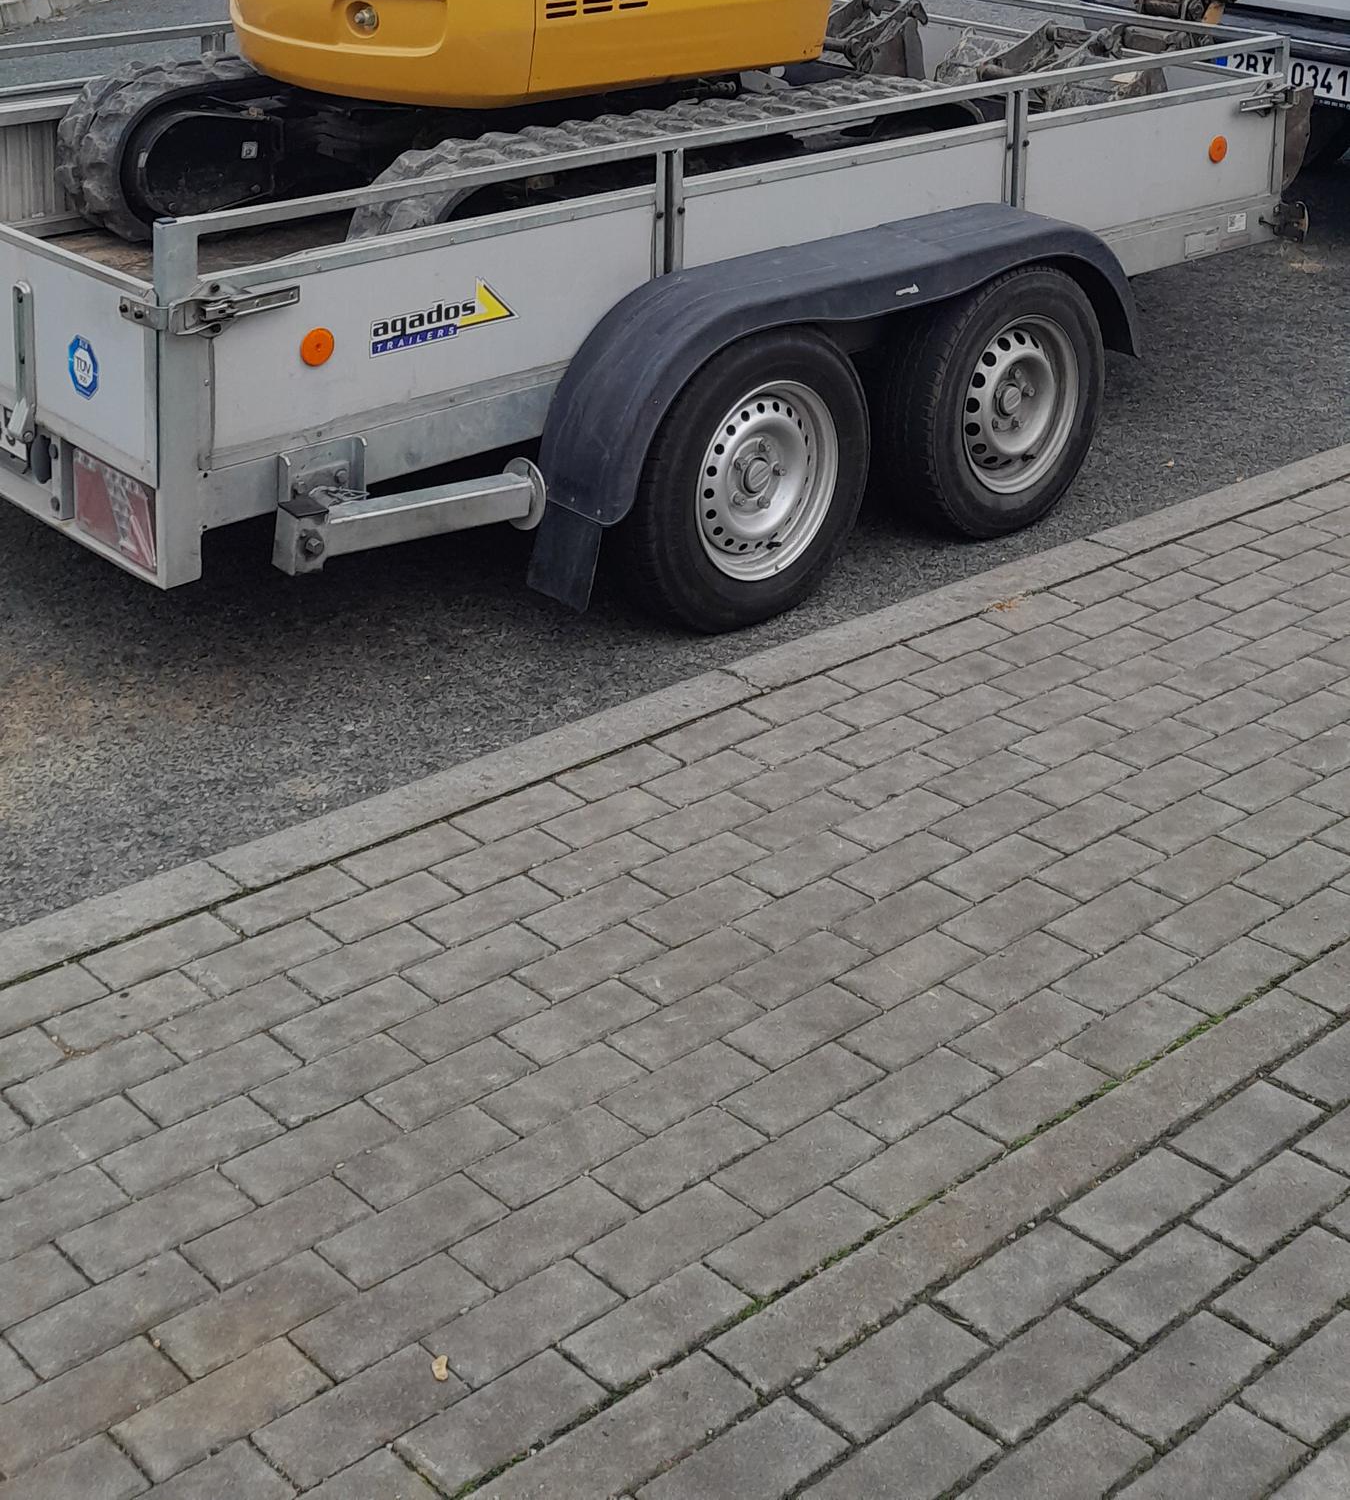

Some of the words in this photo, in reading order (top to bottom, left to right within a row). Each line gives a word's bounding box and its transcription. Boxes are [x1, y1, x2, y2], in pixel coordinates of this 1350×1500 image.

[1290, 62, 1349, 97] 0341
[373, 301, 475, 334] agados
[376, 326, 456, 352] TRAILERS
